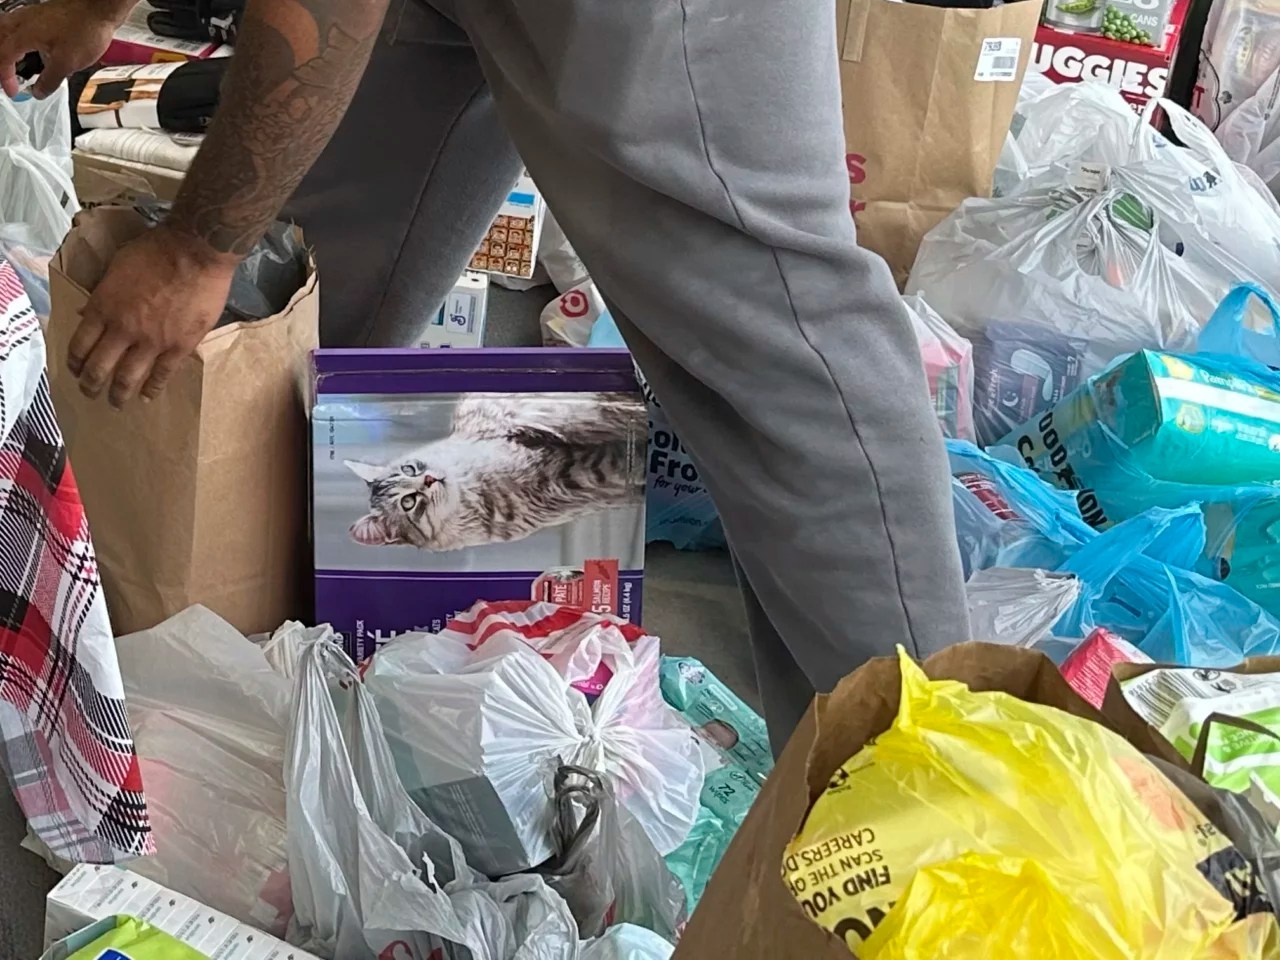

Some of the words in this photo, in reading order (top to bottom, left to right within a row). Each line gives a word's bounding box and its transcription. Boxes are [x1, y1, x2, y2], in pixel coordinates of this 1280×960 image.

[1129, 11, 1159, 27] CANS
[1032, 42, 1169, 99] UGGIES
[653, 474, 672, 489] for
[592, 579, 601, 605] SALMON
[602, 583, 612, 605] RECIPE
[622, 582, 633, 592] kg)
[355, 620, 365, 637] PACK
[718, 782, 736, 798] 72
[839, 848, 884, 873] SCAN
[808, 861, 839, 887] THE
[842, 864, 892, 897] FIND
